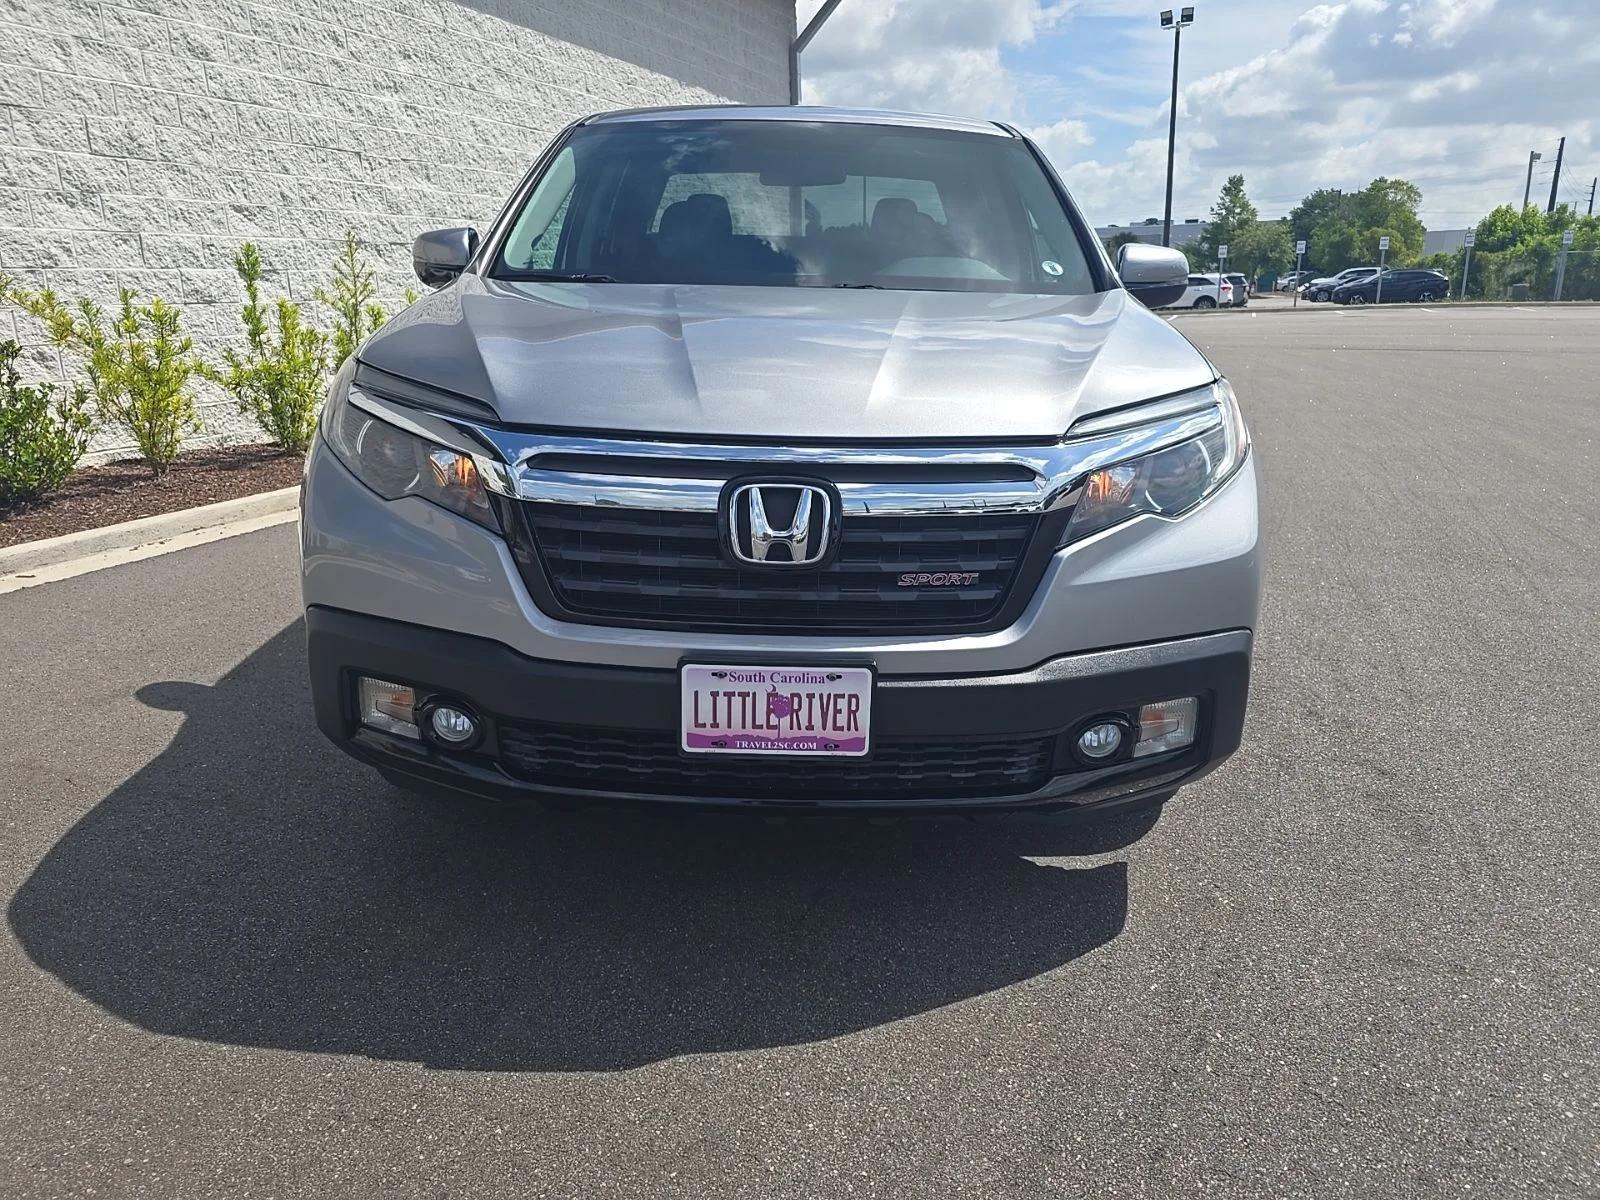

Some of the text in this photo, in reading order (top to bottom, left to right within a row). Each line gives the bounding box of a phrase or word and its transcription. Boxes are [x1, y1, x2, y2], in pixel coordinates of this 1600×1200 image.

[897, 572, 979, 586] SPORT
[728, 671, 825, 684] South Carolina
[693, 690, 860, 732] LITTLE RIVER
[735, 741, 817, 750] TRAVEL2SC.COM
